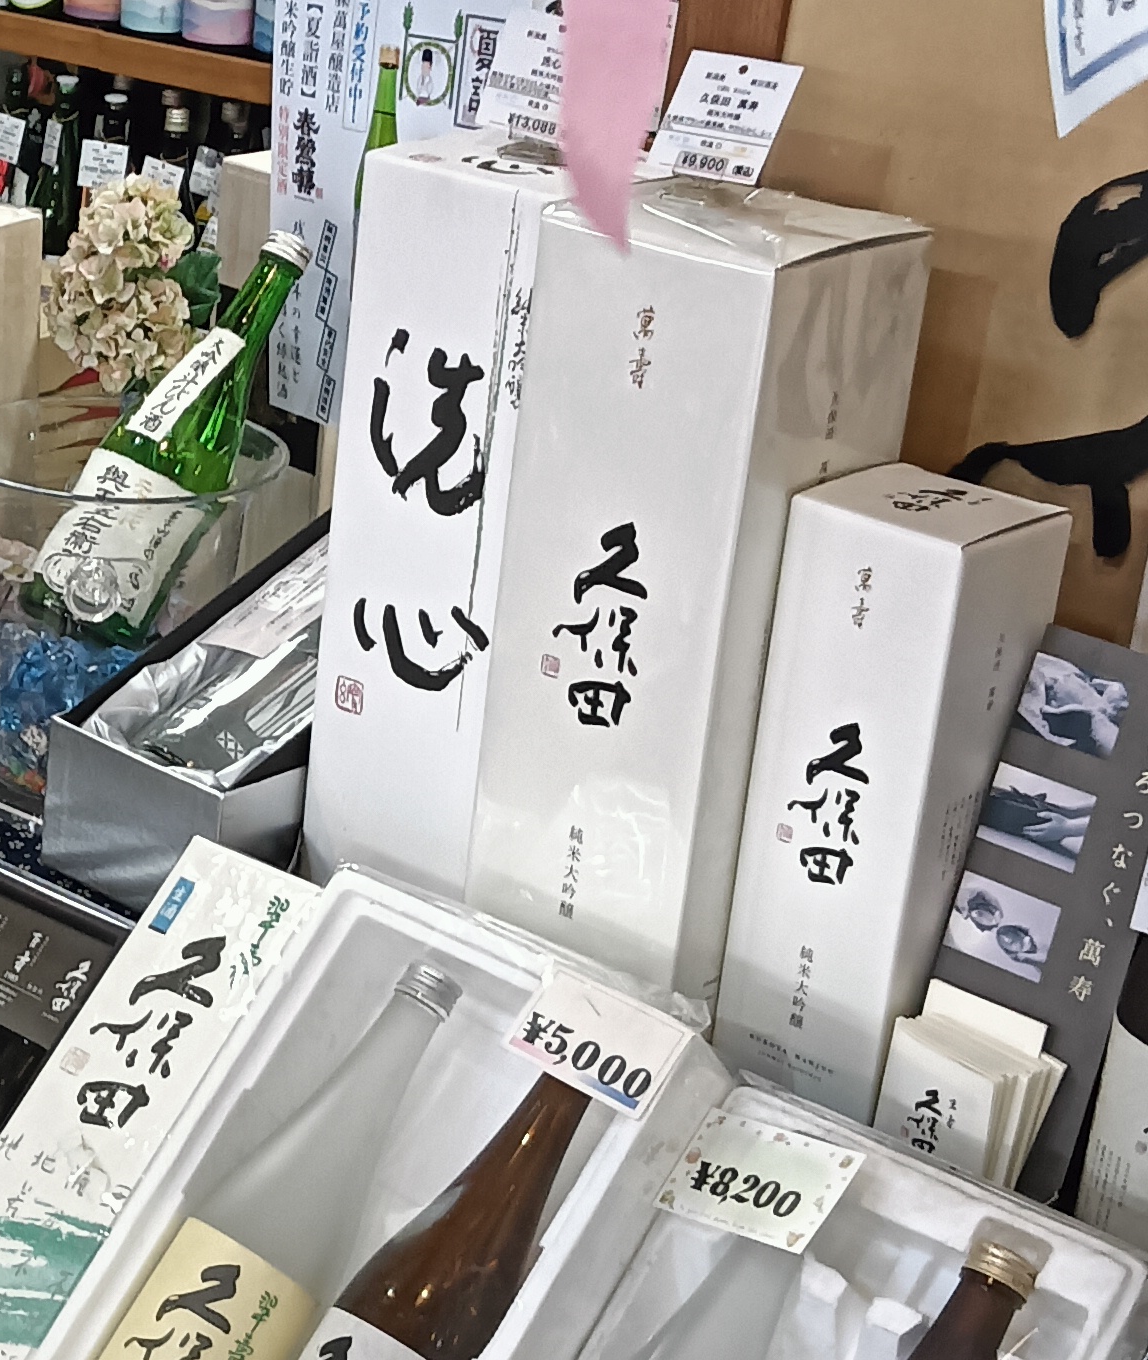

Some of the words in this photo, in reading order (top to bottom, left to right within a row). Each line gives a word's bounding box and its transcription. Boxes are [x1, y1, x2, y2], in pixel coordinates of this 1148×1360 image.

[352, 328, 488, 693] 洗心
[551, 522, 648, 727] 久保田
[788, 721, 871, 886] 久保田
[556, 823, 585, 920] 純米大吟醸
[77, 935, 227, 1130] 久保田
[787, 944, 815, 1029] 純米大吟醸
[520, 1011, 653, 1101] ¥5,000
[688, 1157, 803, 1220] ¥8,200
